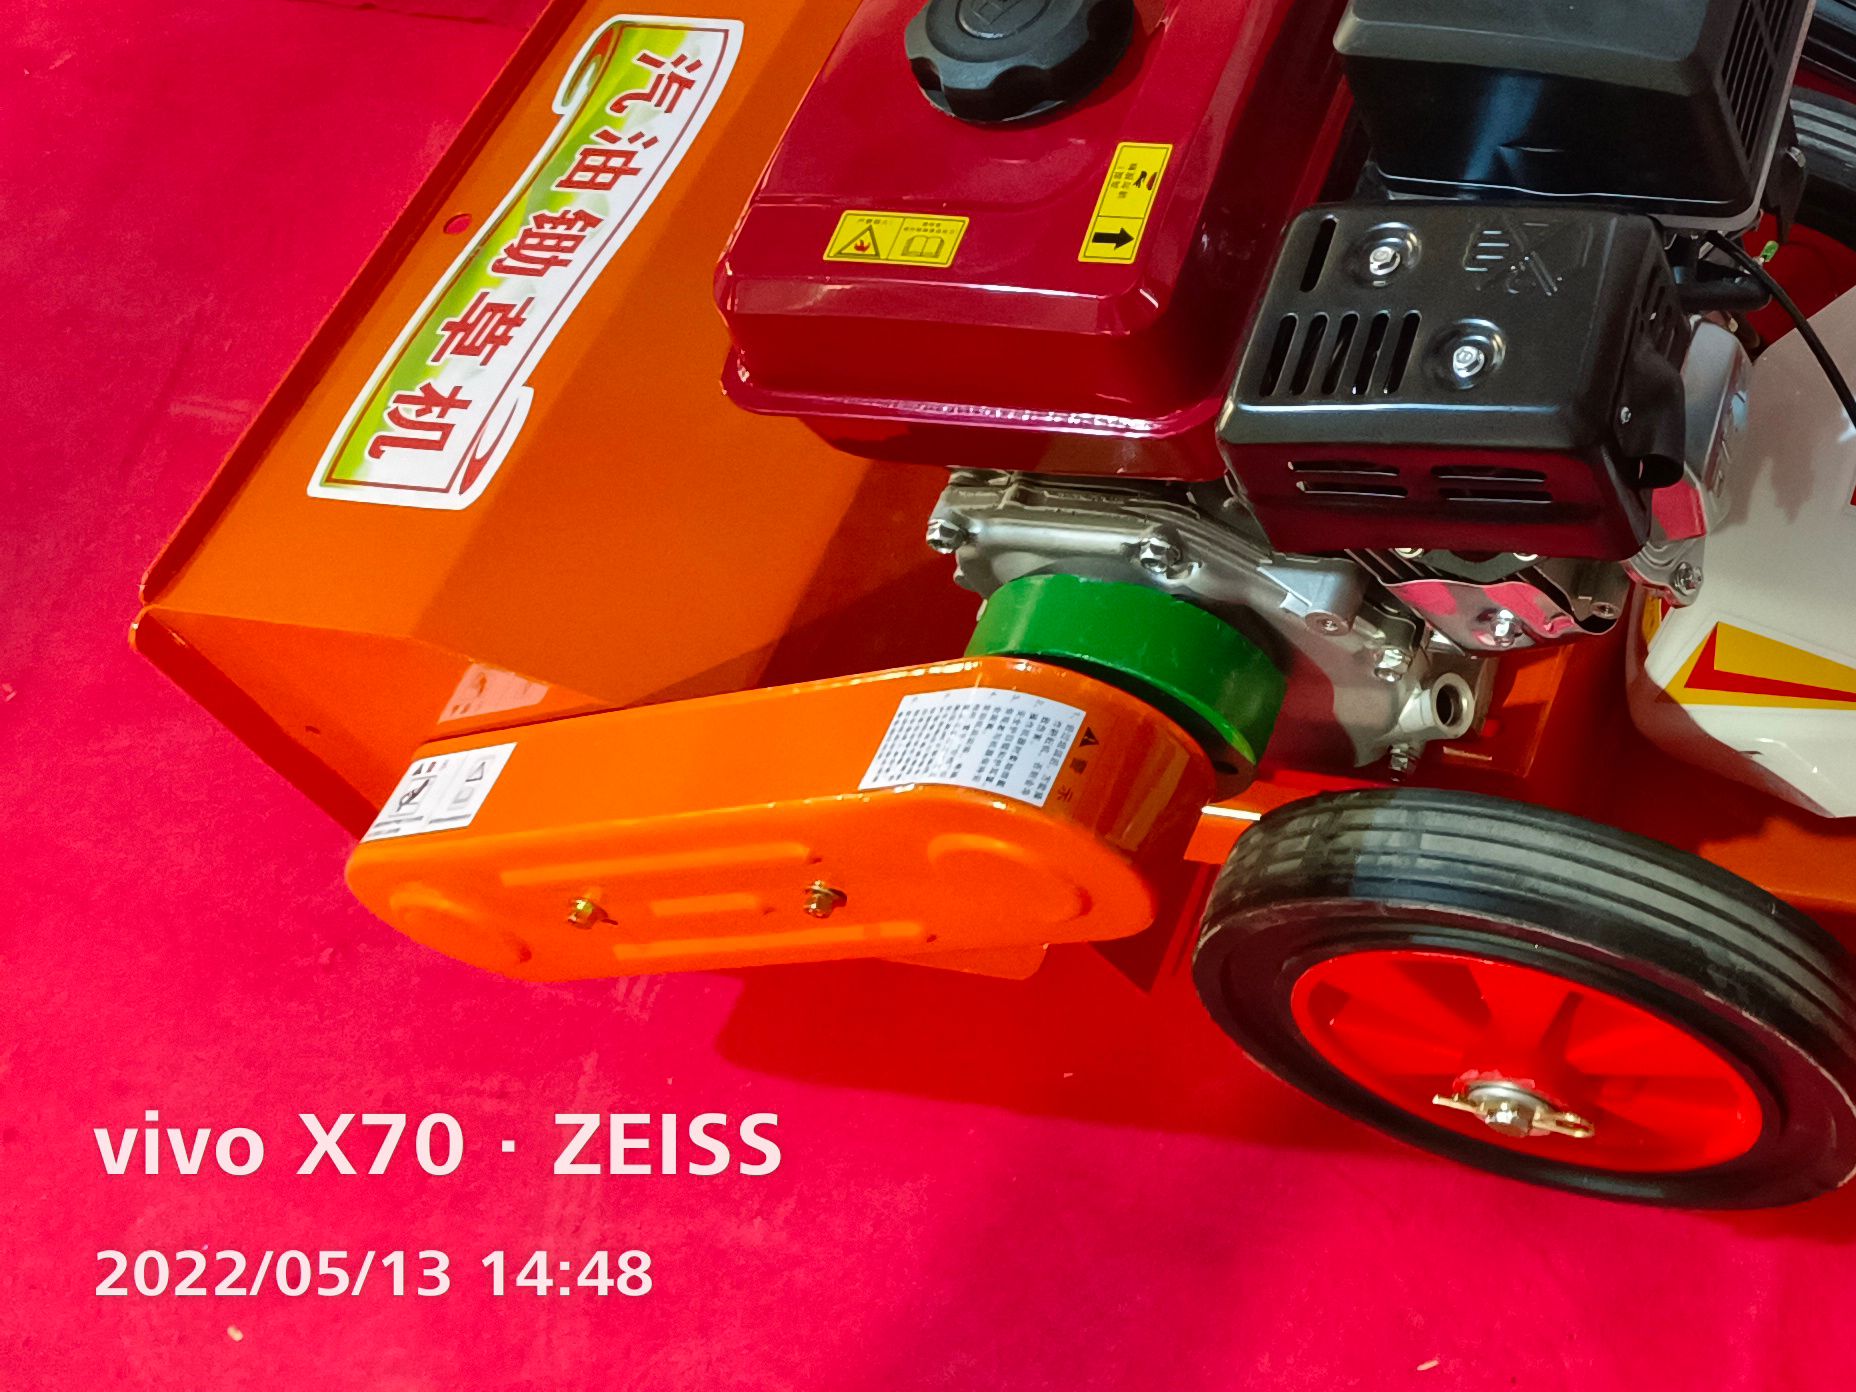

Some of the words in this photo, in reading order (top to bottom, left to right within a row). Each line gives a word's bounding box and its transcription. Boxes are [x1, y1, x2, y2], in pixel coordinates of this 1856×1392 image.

[366, 49, 705, 461] 汽油锄草机
